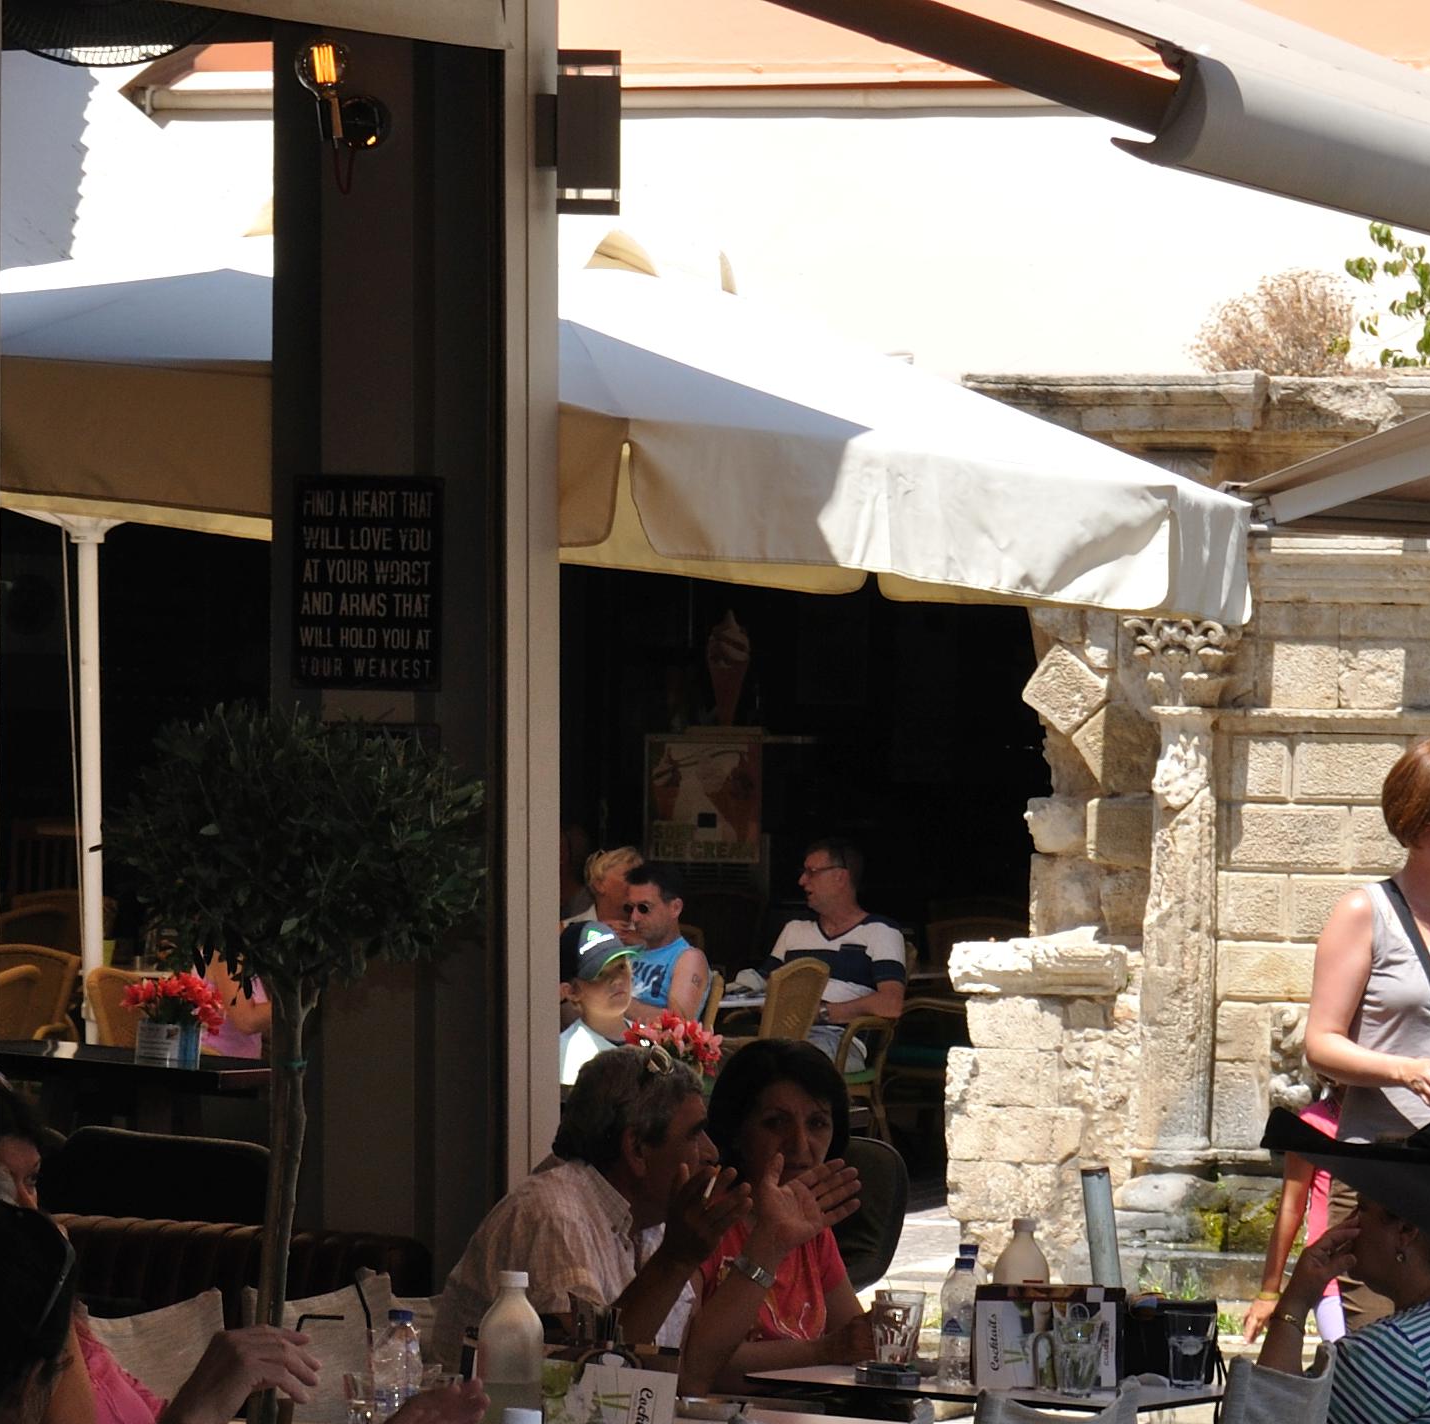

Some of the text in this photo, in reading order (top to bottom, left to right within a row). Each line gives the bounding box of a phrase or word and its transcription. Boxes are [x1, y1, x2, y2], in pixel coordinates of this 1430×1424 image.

[303, 490, 433, 518] FIND A HEART THAT
[303, 526, 431, 551] WILL LOVE YOU
[303, 559, 430, 585] AT YOUR WORST
[301, 592, 430, 618] AND ARMS THAT
[300, 627, 431, 650] WILL HOLD YOU AT
[300, 657, 431, 679] YOUR WEAKEST
[987, 1313, 1000, 1371] Cocktails
